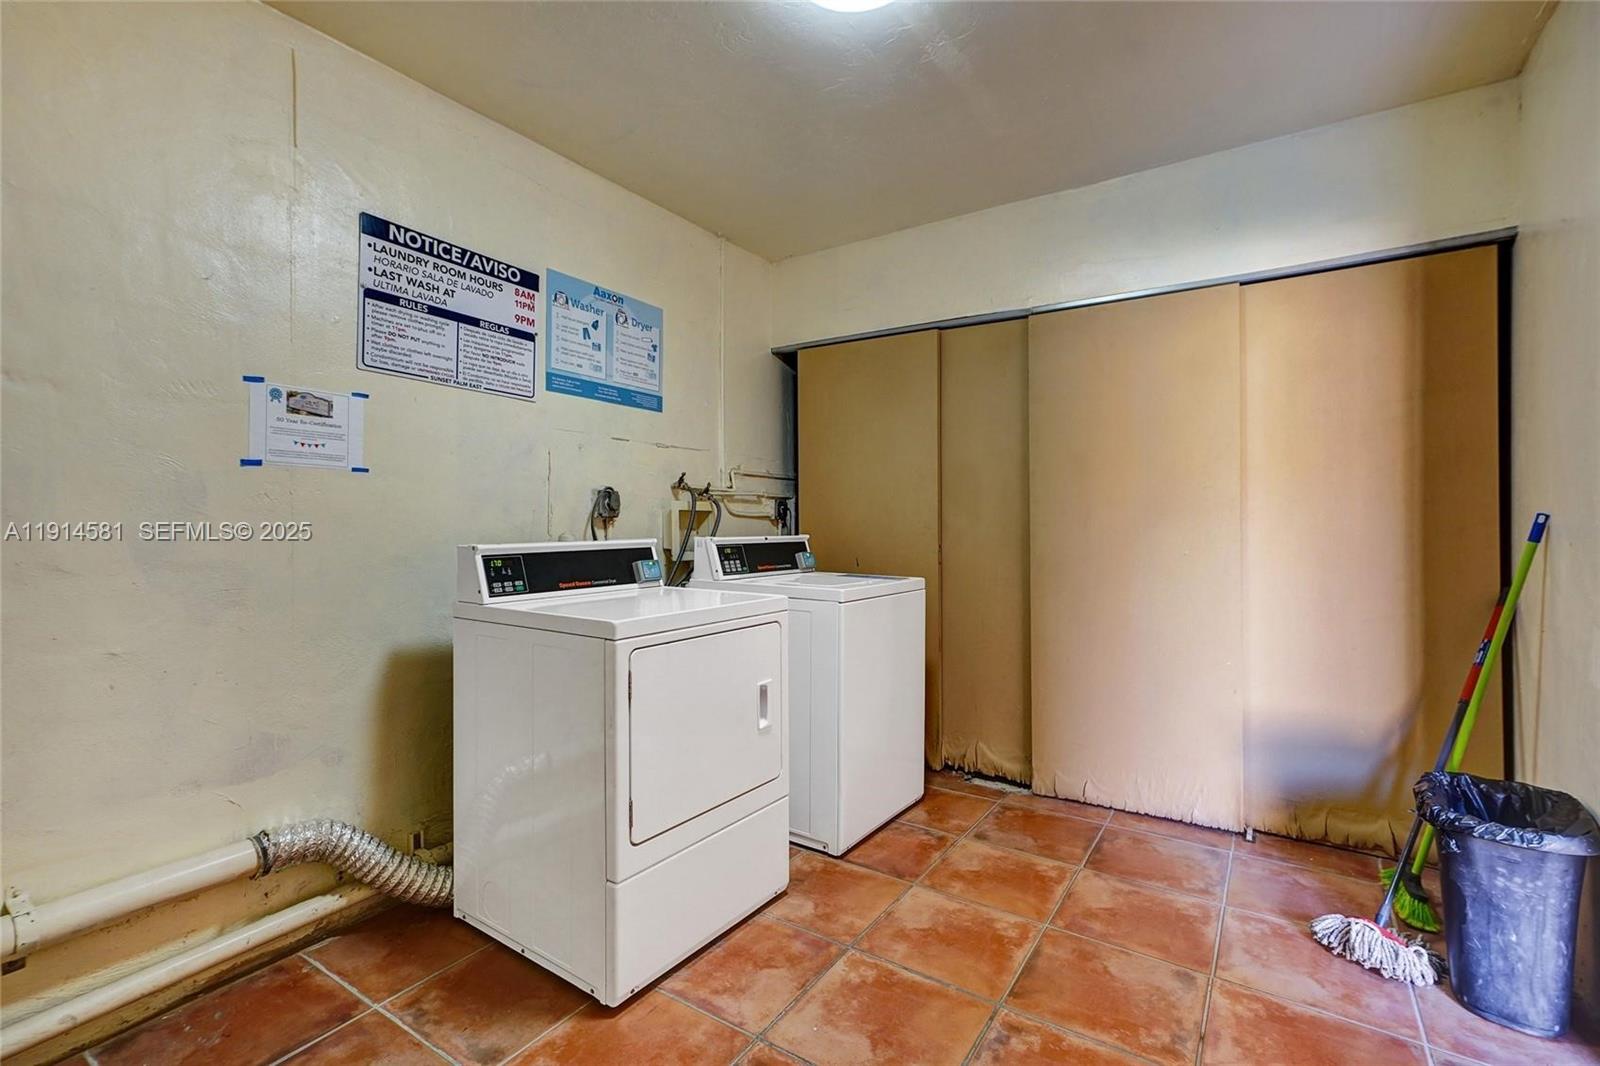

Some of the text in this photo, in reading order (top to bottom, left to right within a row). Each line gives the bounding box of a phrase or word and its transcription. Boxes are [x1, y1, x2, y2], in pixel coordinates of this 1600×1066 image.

[389, 224, 520, 282] NOTICE/AVISO
[374, 242, 504, 292] LAUNDRY ROOM HOURS
[374, 255, 494, 298] HORARIO SALA DE LAVADO
[374, 266, 456, 298] LAST WASH AT
[373, 279, 448, 307] ULTIMA LAVADA
[514, 288, 535, 302] 8AM
[593, 286, 624, 304] Aaxon
[400, 300, 428, 312] RULES
[514, 300, 535, 312] 11PM
[570, 298, 604, 316] Washer
[480, 320, 510, 334] REGLAS
[514, 314, 535, 328] 9PM
[631, 318, 652, 332] Dryer
[430, 376, 452, 384] SUNSET
